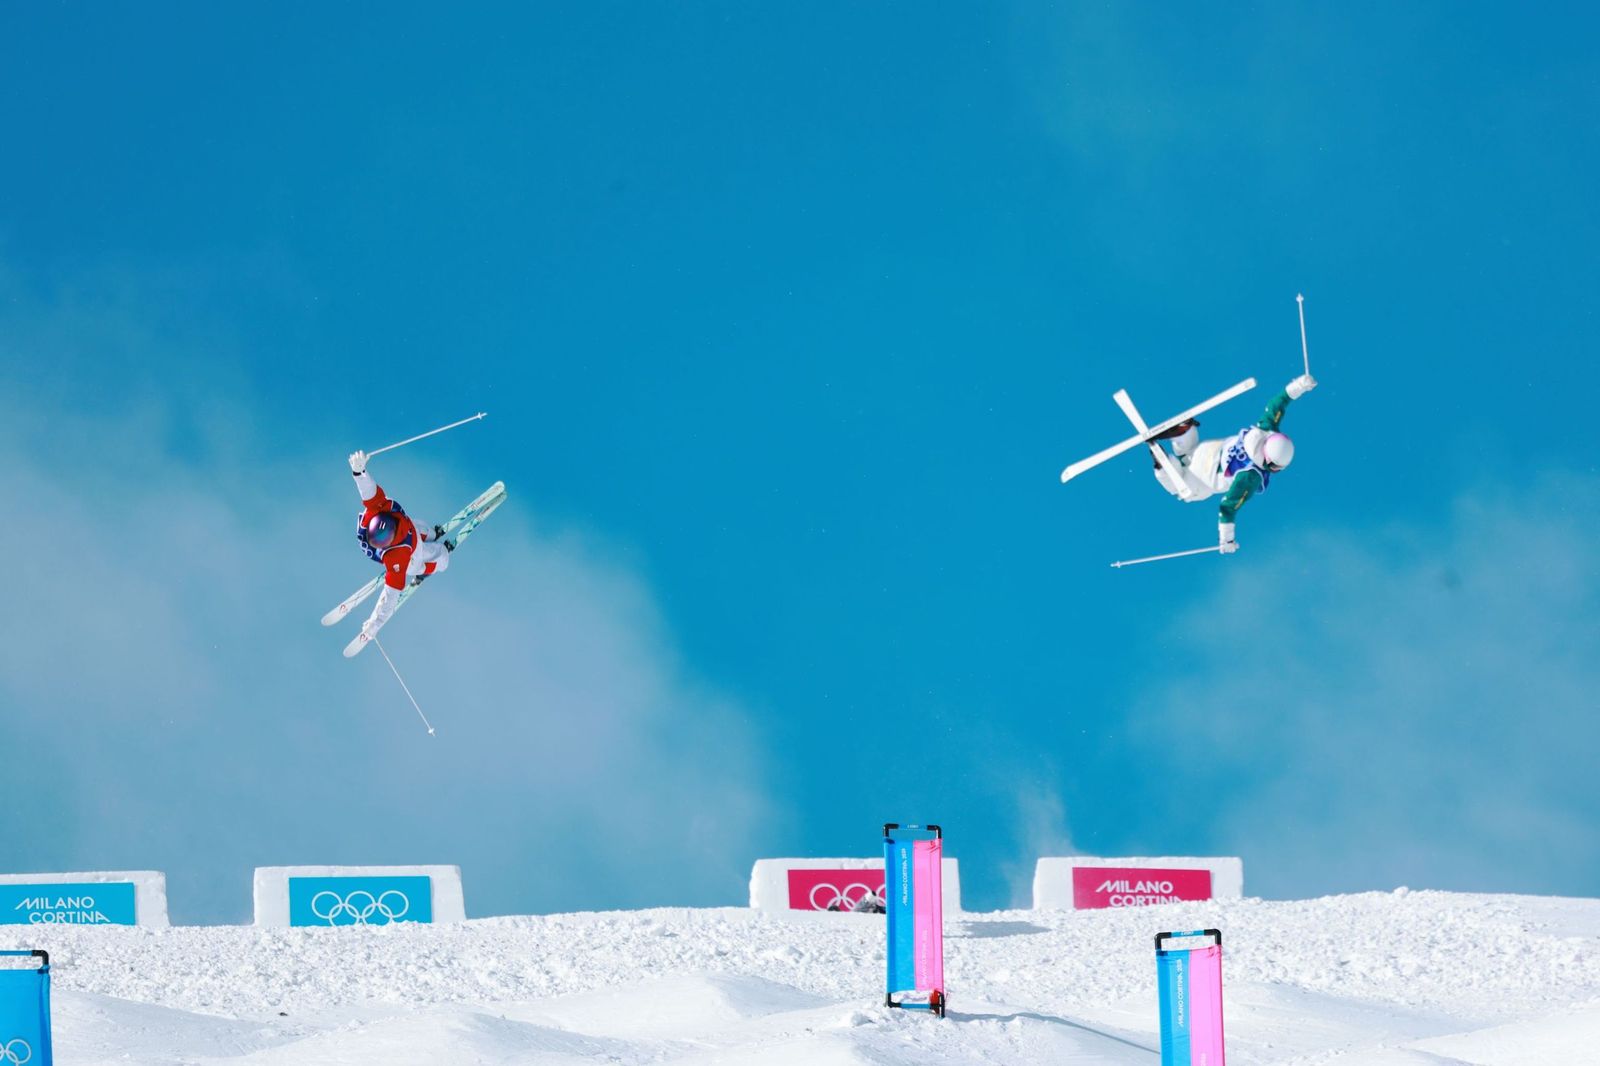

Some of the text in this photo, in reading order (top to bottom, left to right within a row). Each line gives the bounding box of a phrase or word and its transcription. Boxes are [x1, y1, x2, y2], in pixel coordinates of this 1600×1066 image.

[1095, 880, 1173, 894] MILANO
[15, 896, 94, 910] MILANO
[29, 911, 111, 924] CORTINA
